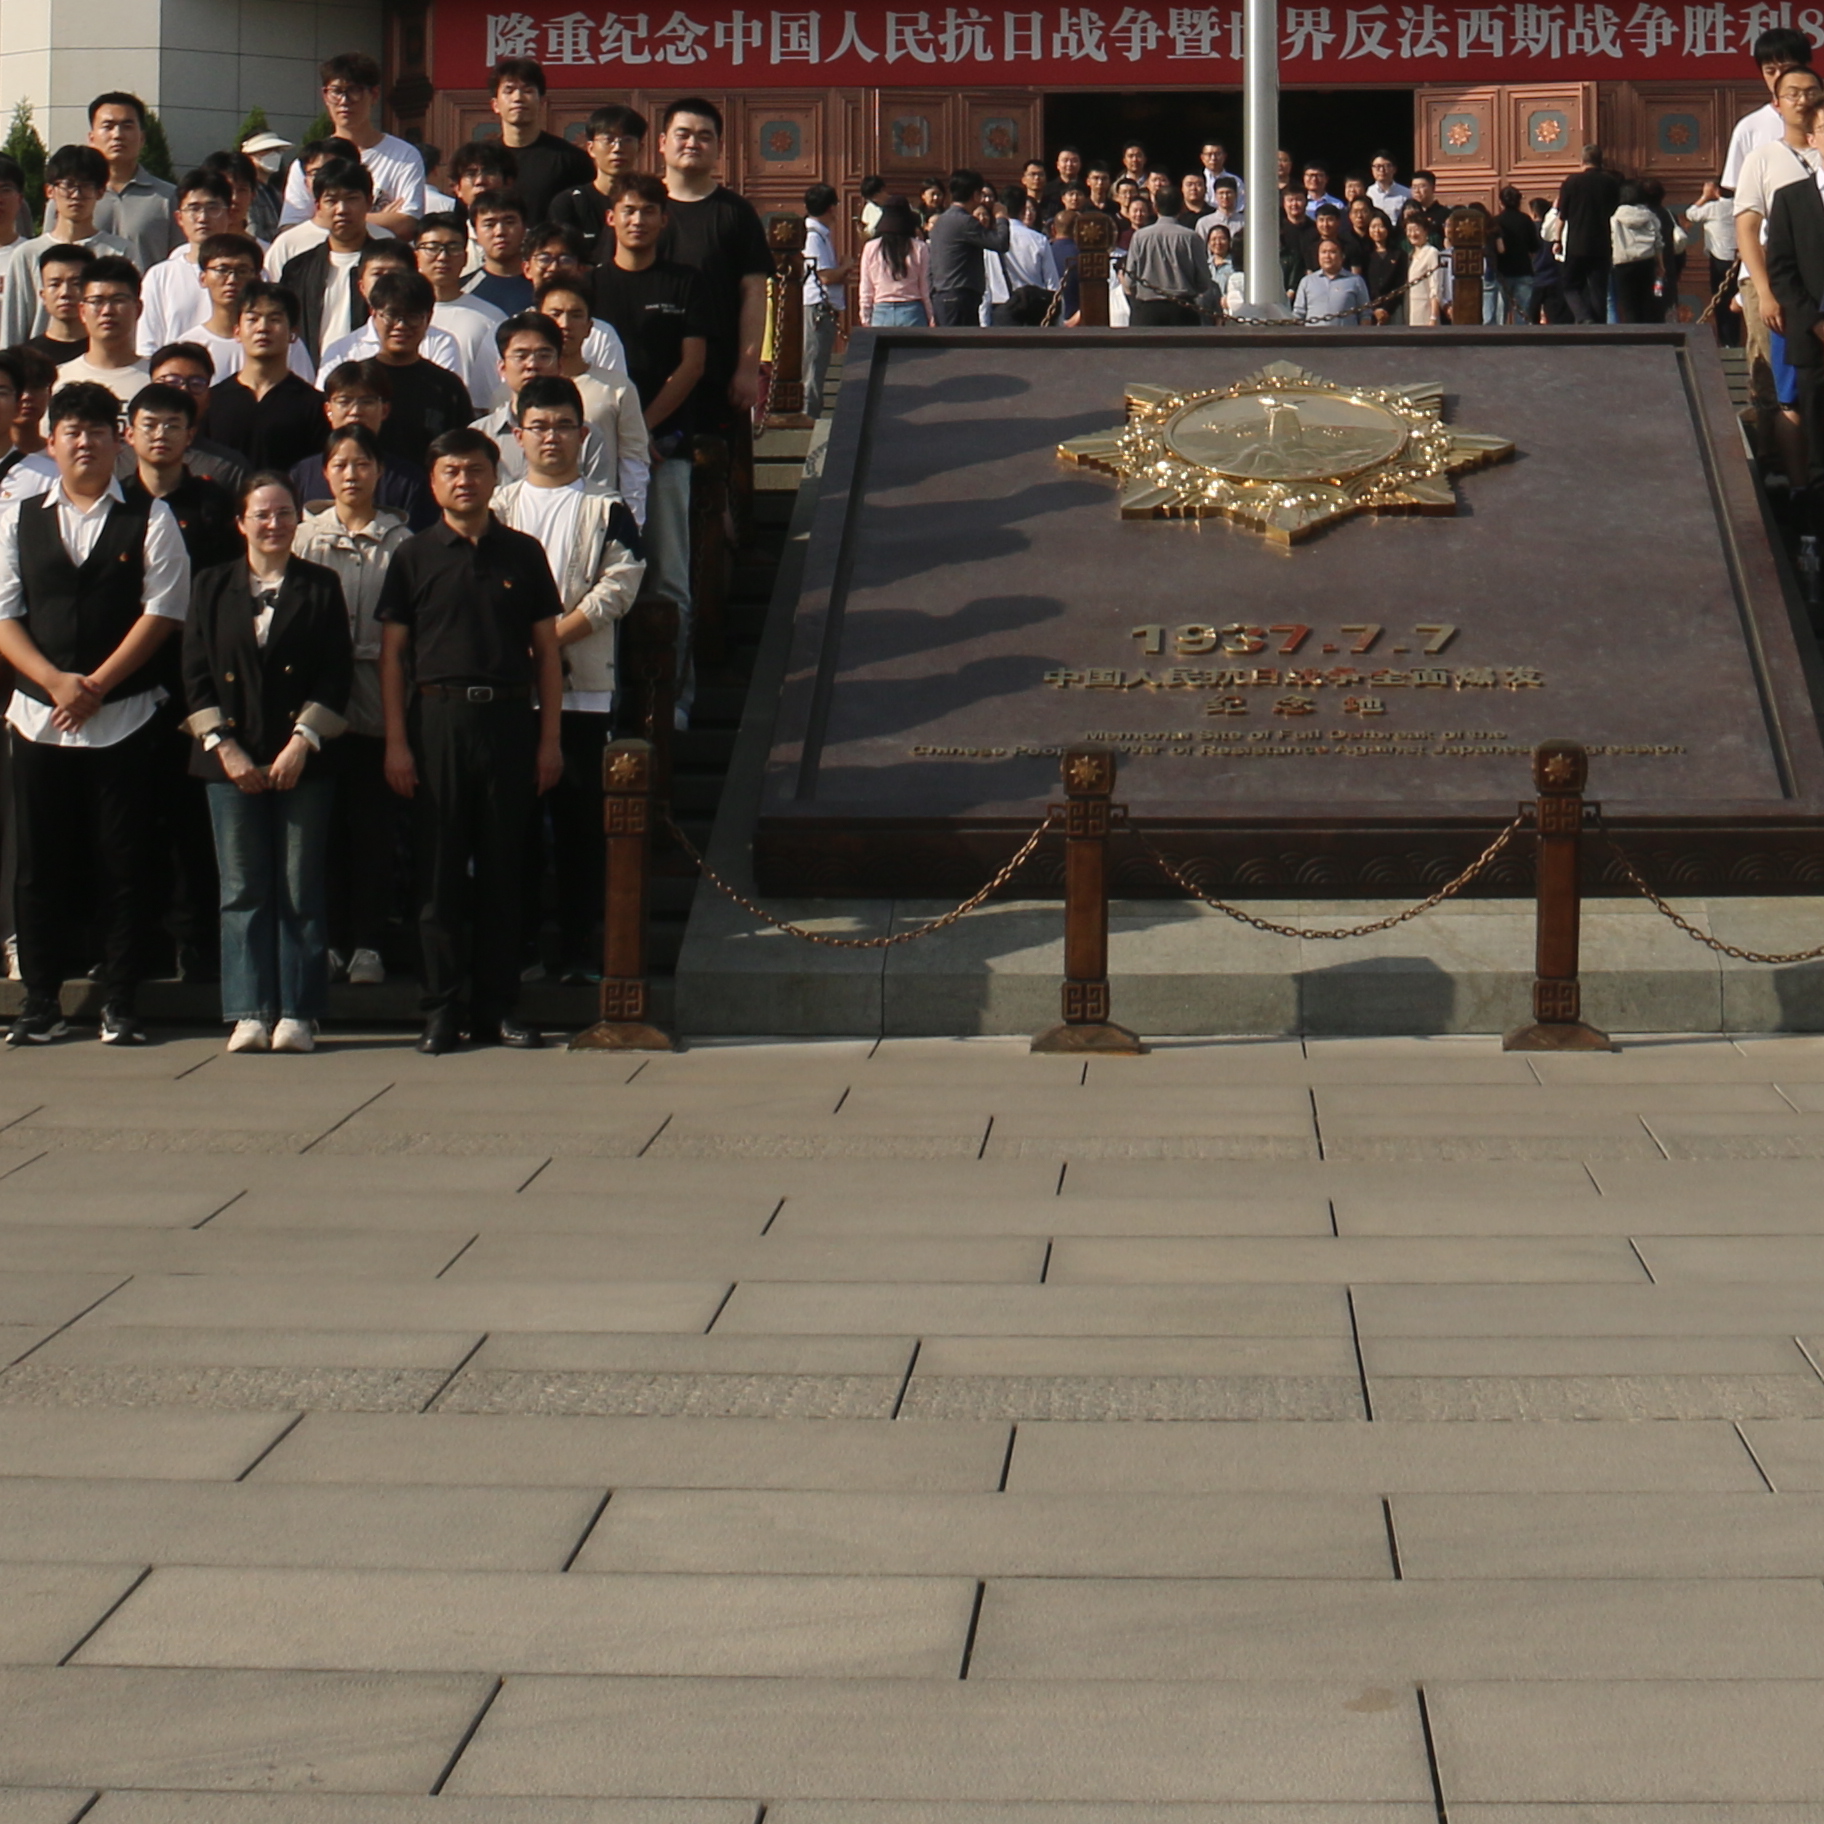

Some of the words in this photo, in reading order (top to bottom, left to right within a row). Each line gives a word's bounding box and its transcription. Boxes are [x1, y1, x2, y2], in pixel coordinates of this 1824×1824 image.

[1130, 622, 1461, 655] 1937.7.7
[1043, 666, 1545, 690] 中国人民抗日战争全面爆发
